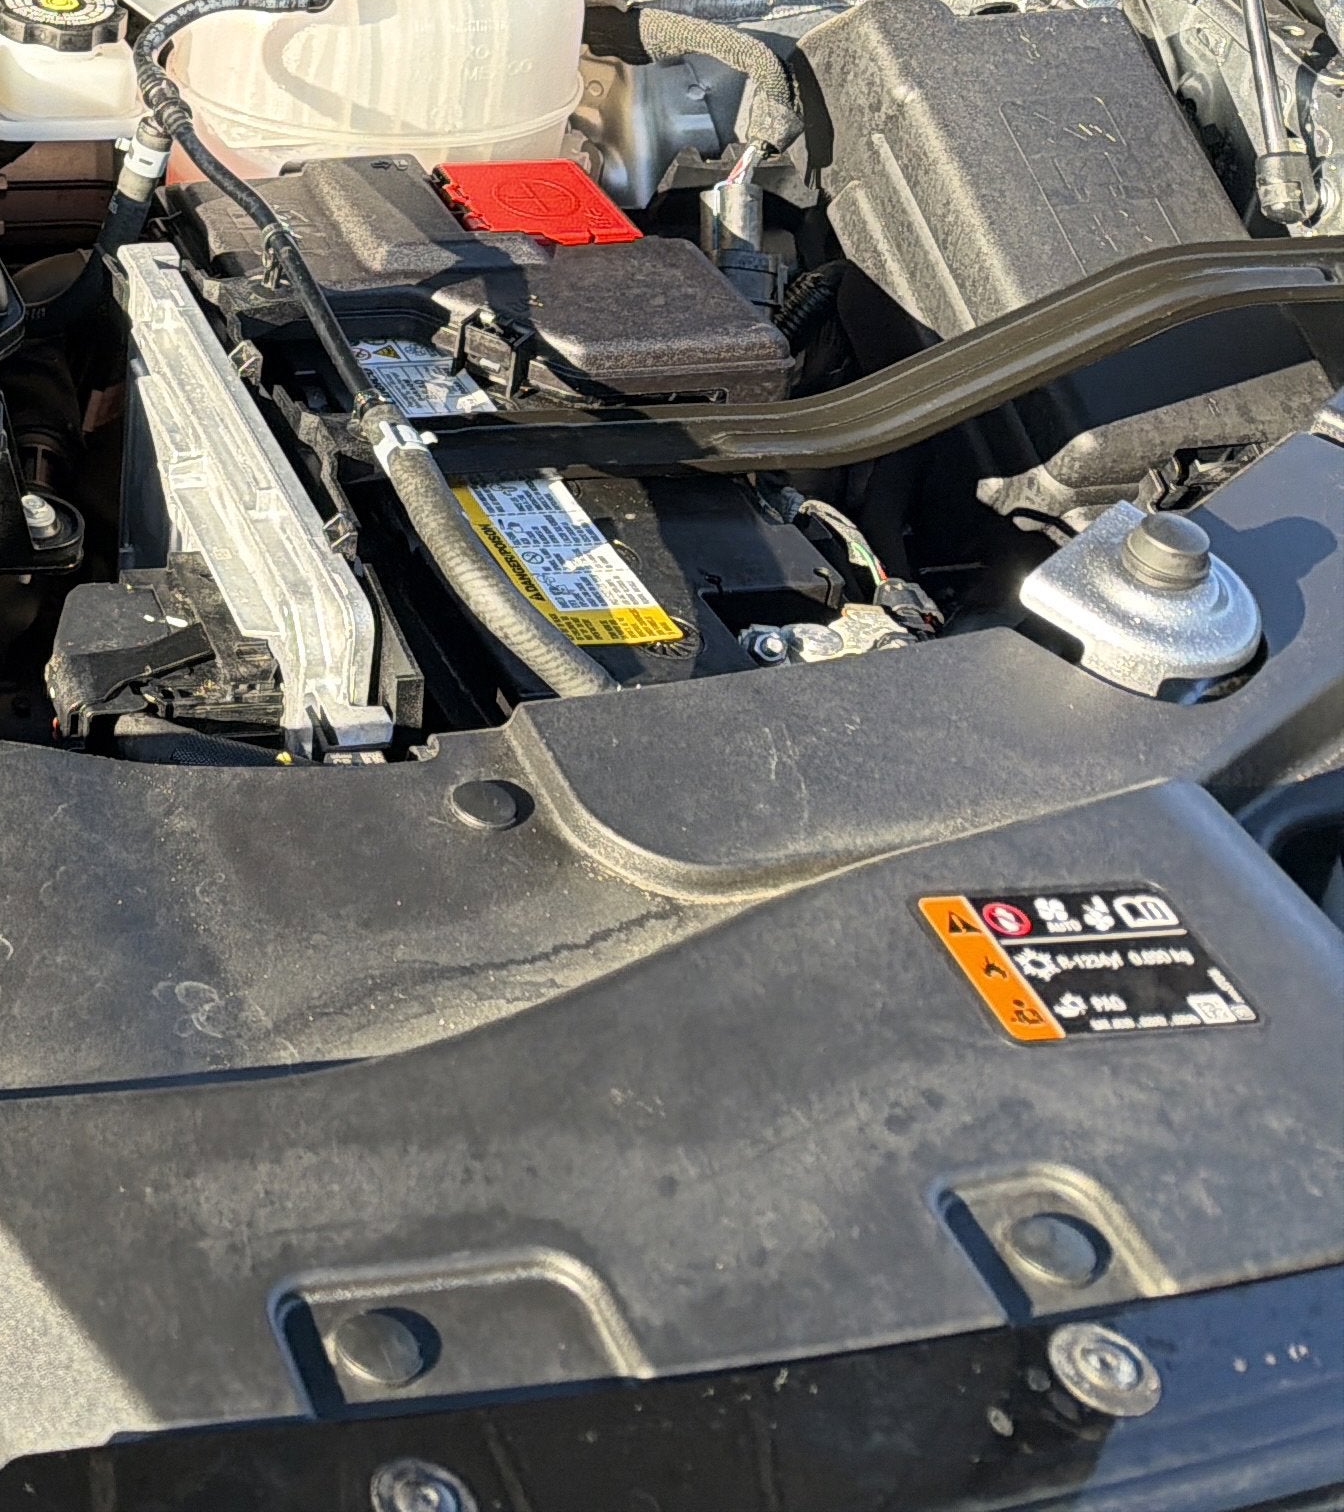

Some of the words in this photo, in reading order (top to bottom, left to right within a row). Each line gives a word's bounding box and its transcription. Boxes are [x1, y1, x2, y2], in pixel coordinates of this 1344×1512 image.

[477, 523, 539, 593] DANGER/POISON
[1047, 920, 1082, 933] AUTO
[1170, 947, 1195, 965] kg
